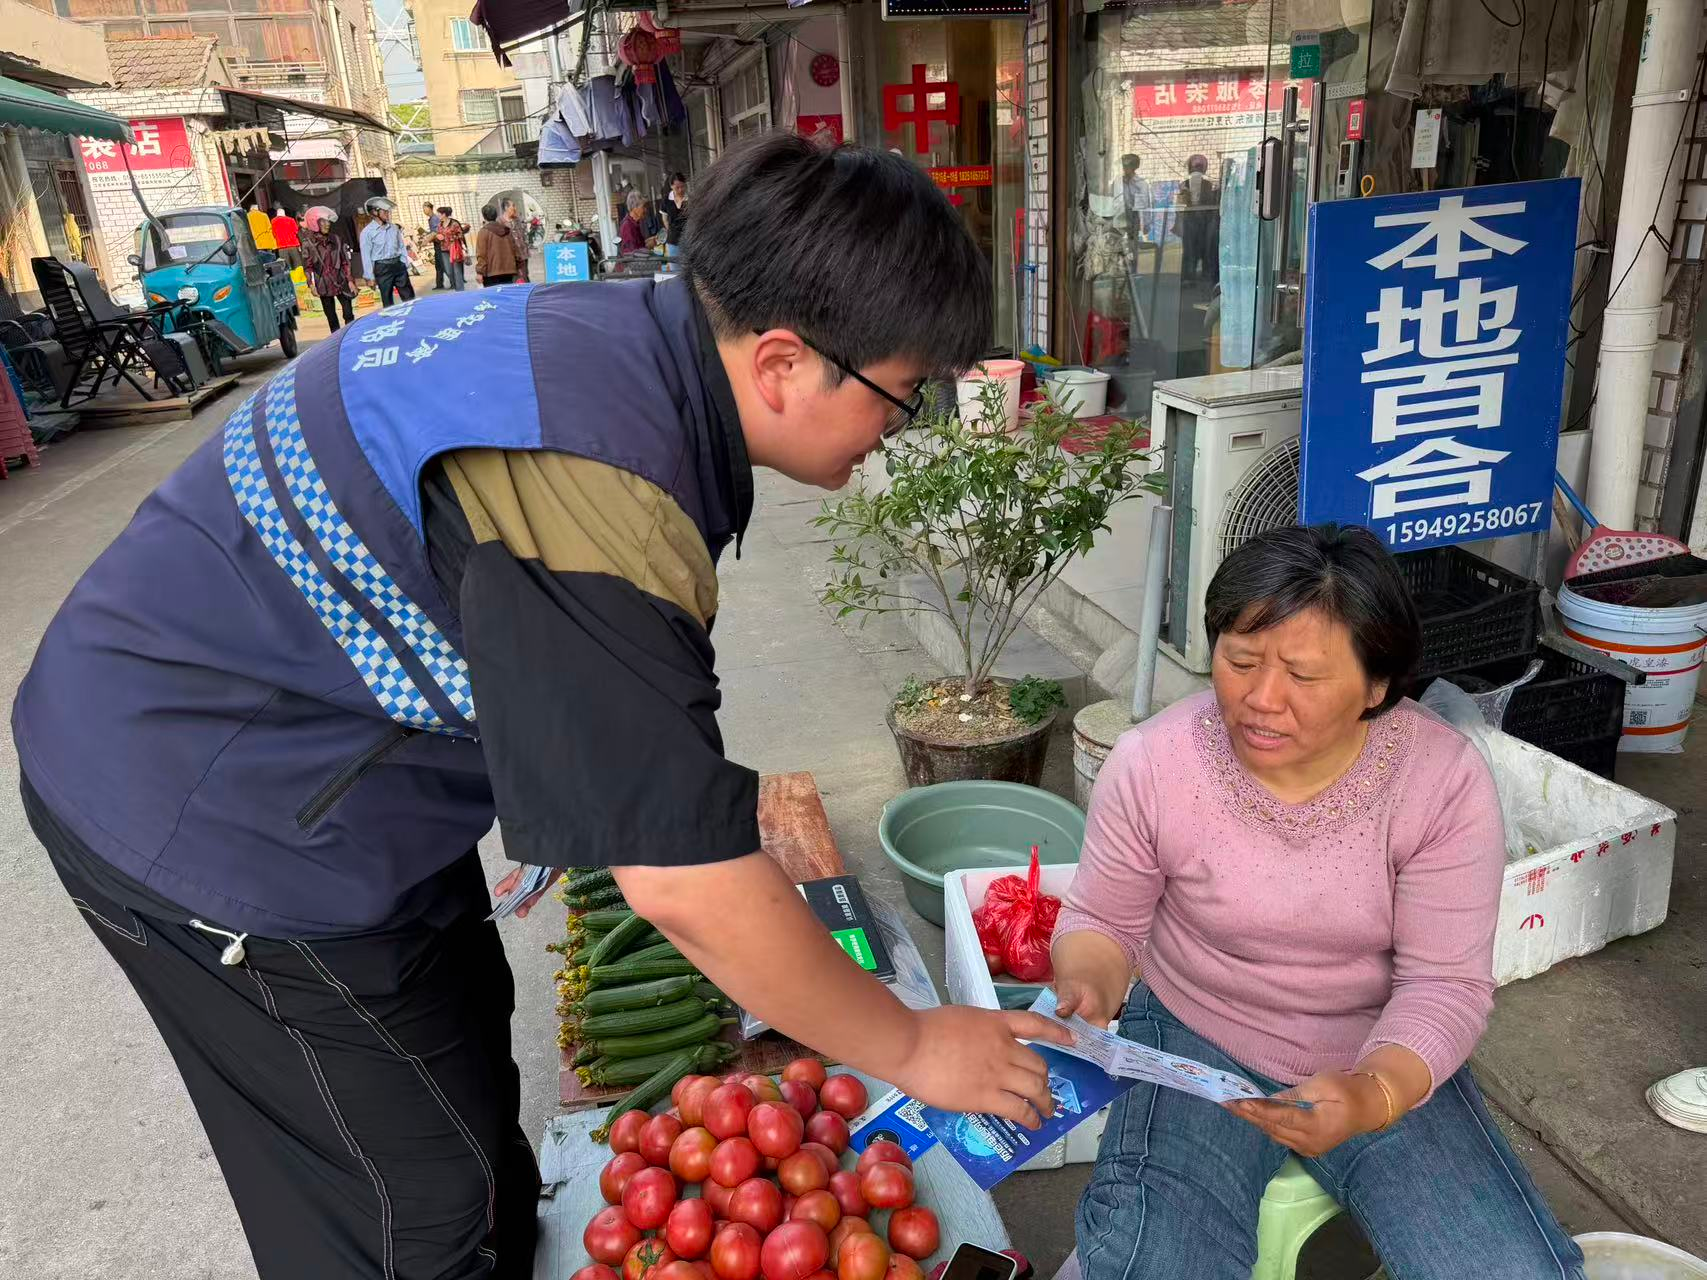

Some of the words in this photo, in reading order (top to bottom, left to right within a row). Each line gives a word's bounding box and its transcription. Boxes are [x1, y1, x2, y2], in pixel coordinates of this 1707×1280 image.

[1298, 52, 1313, 69] 拉
[883, 64, 960, 153] 中
[1355, 195, 1529, 519] 本地百合
[1386, 501, 1543, 545] 15949258067
